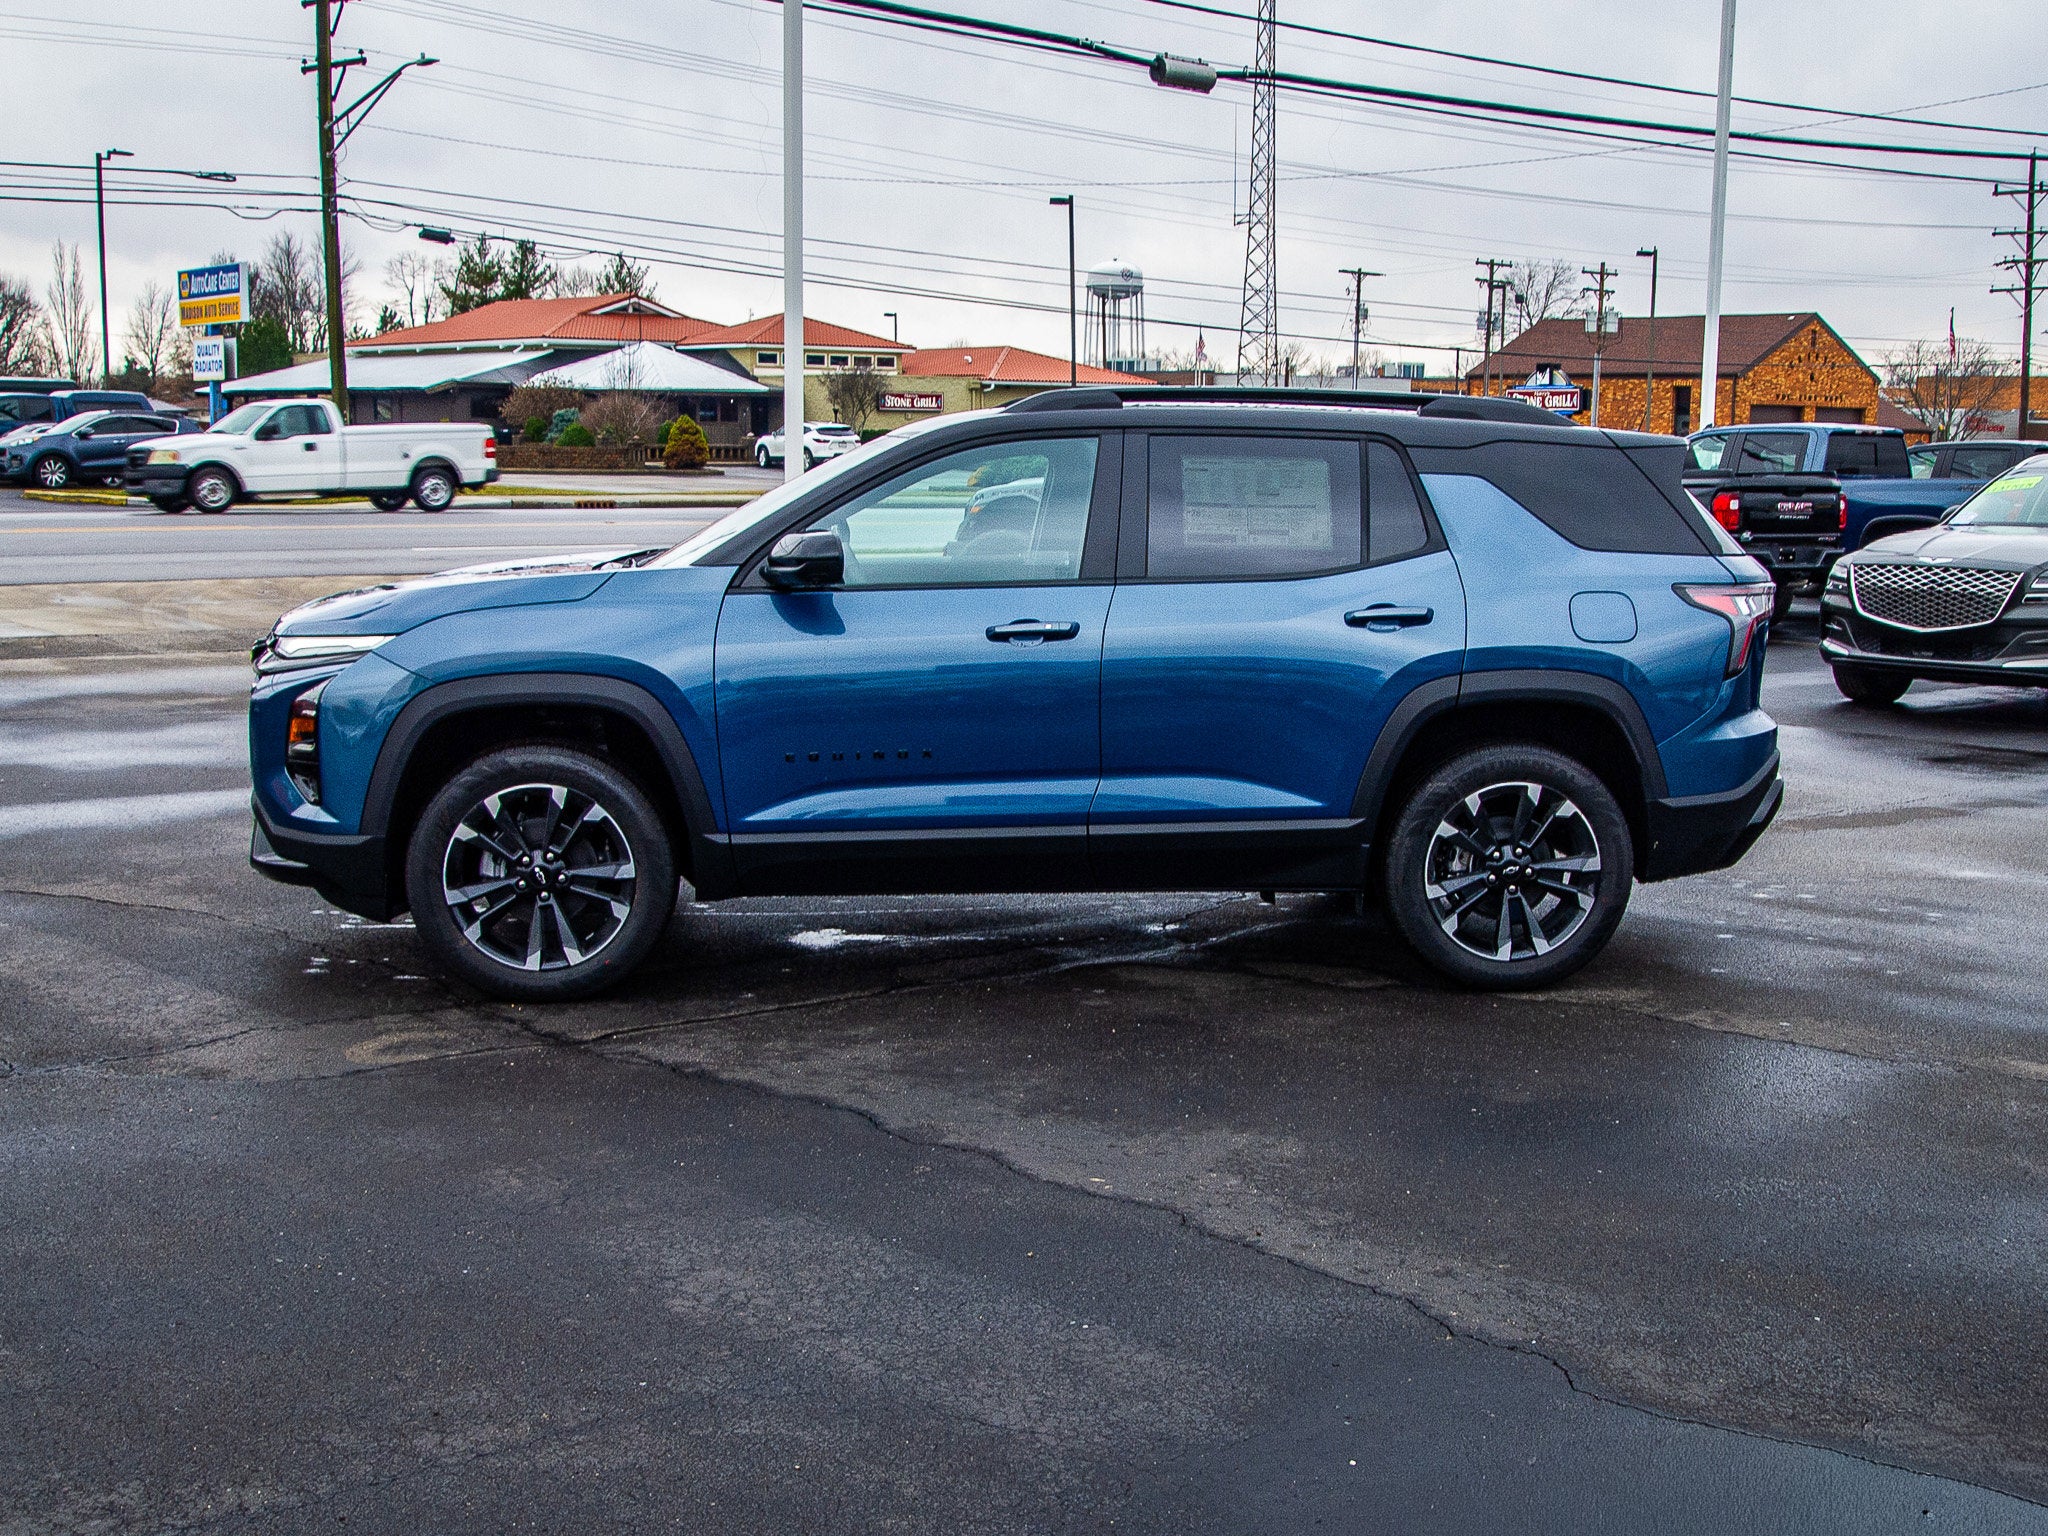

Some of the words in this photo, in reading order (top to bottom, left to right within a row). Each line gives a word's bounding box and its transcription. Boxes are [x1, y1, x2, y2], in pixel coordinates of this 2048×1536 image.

[218, 270, 239, 290] CENTER
[196, 344, 220, 357] QUALITY
[195, 360, 222, 372] RADIATOR
[885, 394, 912, 407] STONE
[913, 396, 938, 408] GRILL
[1544, 393, 1573, 407] GRILL
[785, 749, 932, 763] EQUINOX
